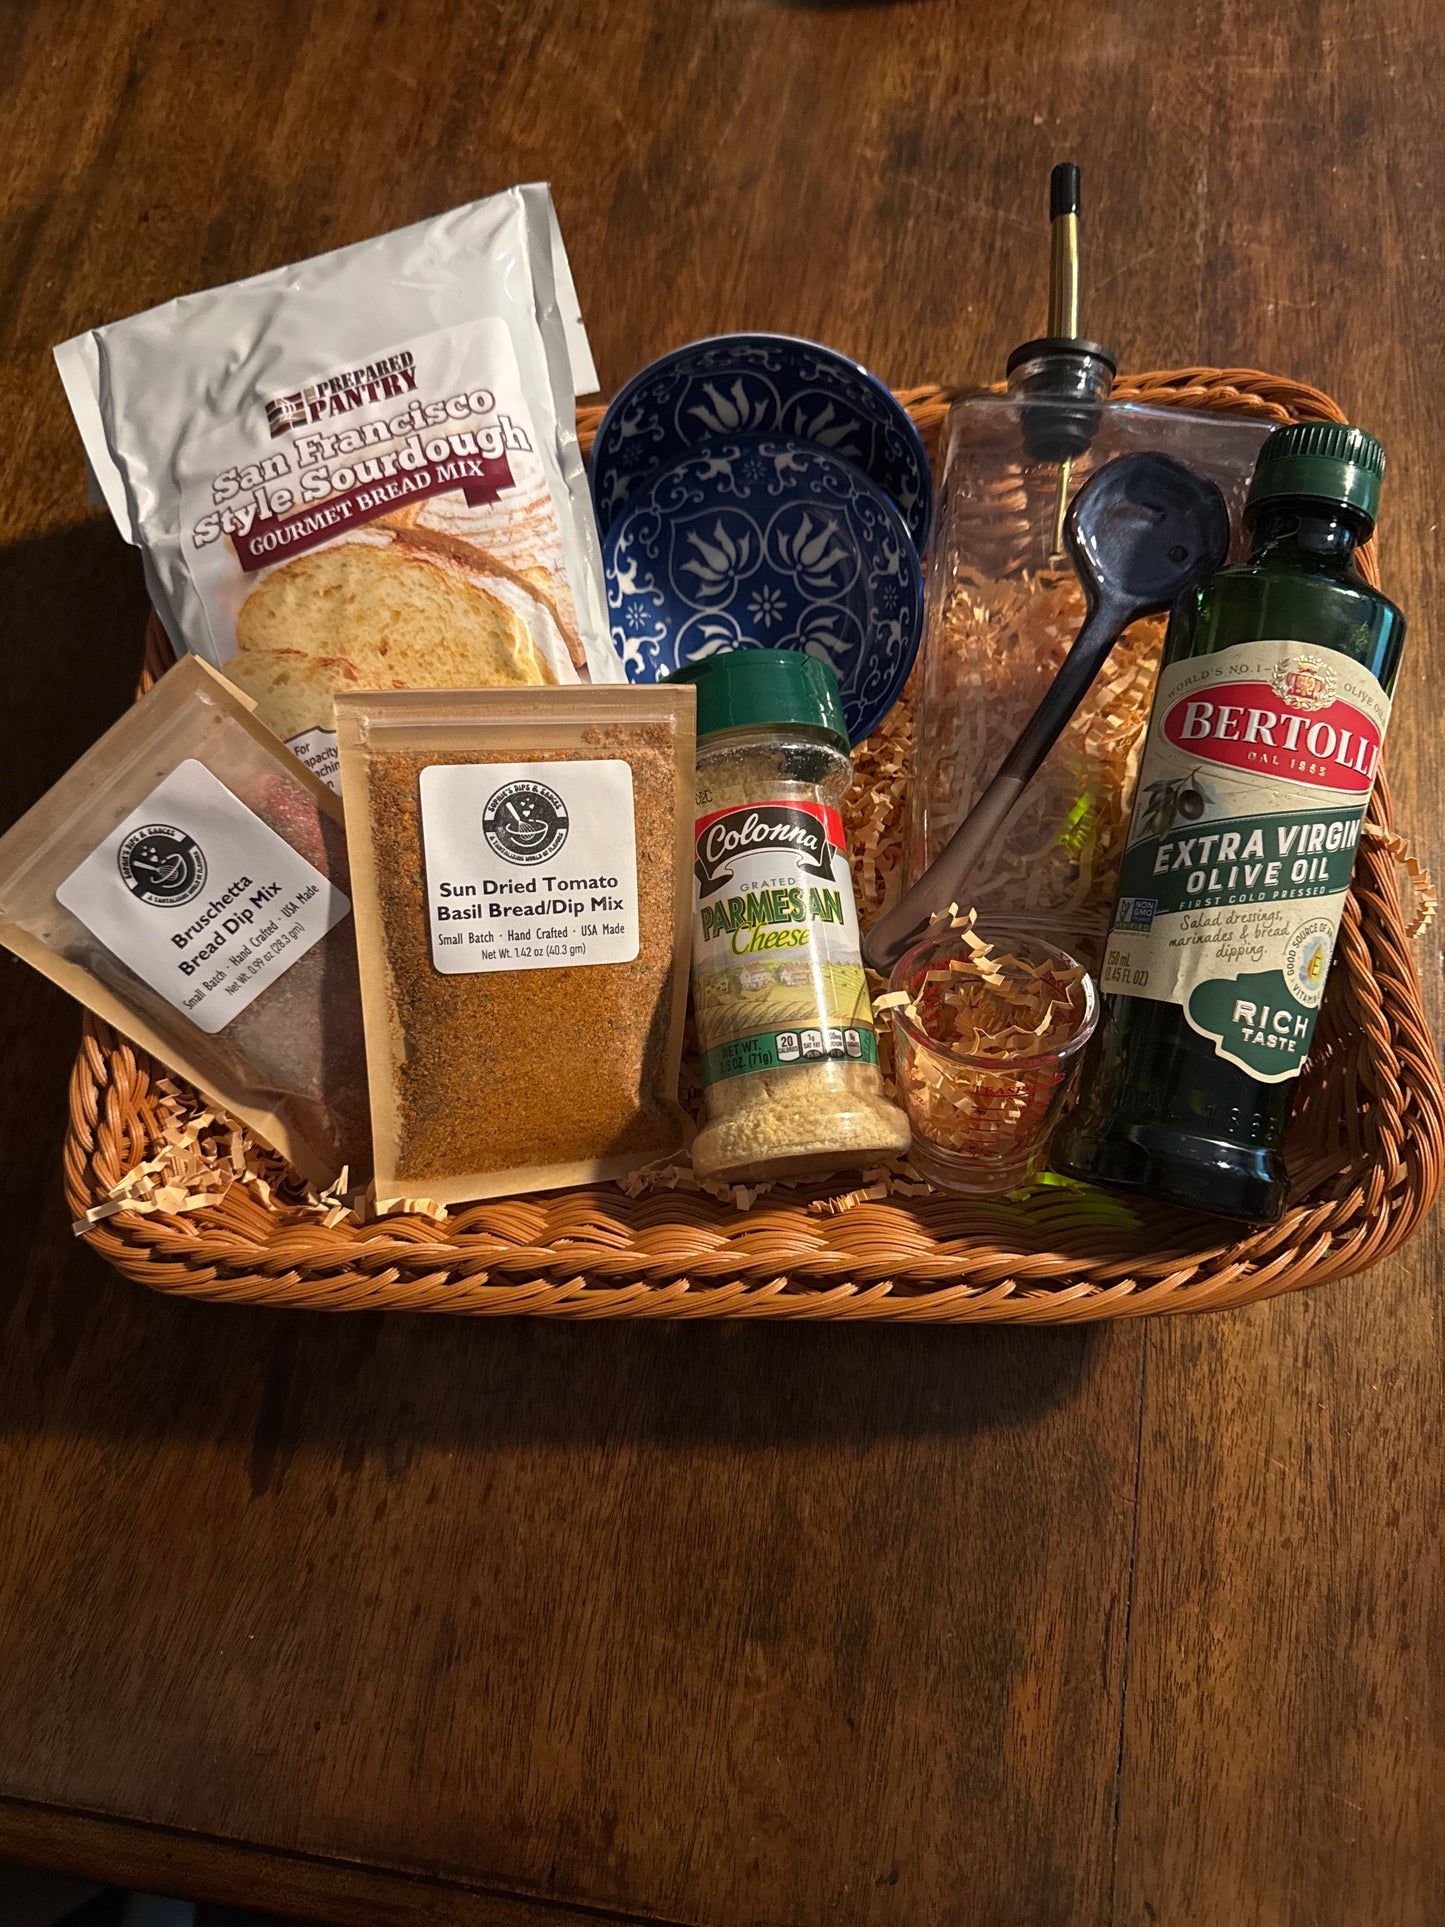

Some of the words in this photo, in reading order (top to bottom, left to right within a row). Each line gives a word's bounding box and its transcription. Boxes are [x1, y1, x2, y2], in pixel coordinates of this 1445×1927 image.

[317, 351, 414, 398] PREPARED
[308, 366, 419, 423] PANTRY
[212, 451, 291, 505] San
[294, 388, 495, 467] Francisco
[193, 486, 294, 548] Style
[300, 414, 533, 503] Sourdough
[250, 502, 353, 556] GOURMET
[359, 471, 431, 512] BREAD
[436, 460, 485, 485] MIX
[1168, 665, 1223, 698] WORLD'S
[1344, 683, 1374, 706] OLIVE
[294, 743, 310, 757] For
[1178, 701, 1379, 780] BERTOLLI
[304, 746, 338, 769] apacity
[315, 761, 341, 777] achin
[1247, 751, 1279, 766] DAL
[1290, 759, 1327, 777] 1865
[488, 788, 513, 812] SOPHIE'S
[514, 784, 530, 792] DIPS
[540, 788, 562, 810] SAUCES
[706, 812, 818, 863] Colonna
[1152, 827, 1265, 876] EXTRA
[1278, 818, 1361, 858] VIRGIN
[439, 882, 476, 898] Sun
[483, 878, 537, 895] Dried
[542, 875, 619, 892] Tomato
[740, 877, 796, 892] GRATED
[1186, 861, 1282, 895] OLIVE
[1291, 857, 1329, 885] OIL
[437, 903, 482, 921] Basil
[489, 900, 585, 918] Bread/Dip
[591, 896, 624, 912] Mix
[1135, 901, 1154, 909] NON
[1179, 896, 1221, 911] FIRST
[1229, 892, 1266, 904] COLD
[1272, 886, 1326, 900] PRESSED
[171, 876, 253, 950] Bruschetta
[700, 887, 844, 941] PARMESAN
[1133, 908, 1153, 916] GMO
[1180, 913, 1222, 931] Salad
[1225, 909, 1283, 928] dressings,
[178, 931, 227, 976] Bread
[222, 909, 254, 936] Dip
[249, 881, 283, 909] Mix
[438, 932, 463, 946] Small
[469, 931, 494, 944] Batch
[507, 928, 531, 941] Hand
[536, 926, 568, 939] Crafted
[581, 925, 597, 937] USA
[603, 923, 625, 936] Made
[731, 921, 812, 956] Cheese
[1169, 926, 1234, 948] marinades
[1237, 926, 1249, 945] &
[1254, 921, 1290, 938] bread
[183, 988, 206, 1010] Small
[202, 970, 227, 991] Batch
[229, 945, 253, 966] Hand
[250, 920, 279, 948] Crafted
[281, 902, 300, 918] USA
[296, 884, 320, 905] Made
[225, 980, 241, 995] Net
[236, 972, 253, 984] Wt.
[249, 957, 265, 975] 0.99
[264, 951, 275, 961] oz
[270, 934, 291, 954] (28.3
[289, 921, 306, 940] gm)
[481, 950, 496, 960] Net
[498, 949, 512, 960] Wt.
[514, 947, 532, 958] 1.42
[533, 949, 544, 957] oz
[546, 945, 568, 956] (40.3
[570, 943, 586, 955] gm)
[1216, 944, 1268, 962] dipping.
[1287, 950, 1296, 976] GOOD
[1292, 923, 1318, 948] SOURCE
[1121, 968, 1131, 983] FL
[1134, 970, 1149, 987] OZ)
[1232, 1000, 1309, 1039] RICH
[722, 1042, 741, 1059] NET
[742, 1039, 761, 1053] WT.
[780, 1035, 794, 1047] 20
[807, 1033, 815, 1041] 1g
[1242, 1028, 1296, 1053] TASTE
[732, 1056, 747, 1069] OZ.
[750, 1050, 773, 1069] (71g)
